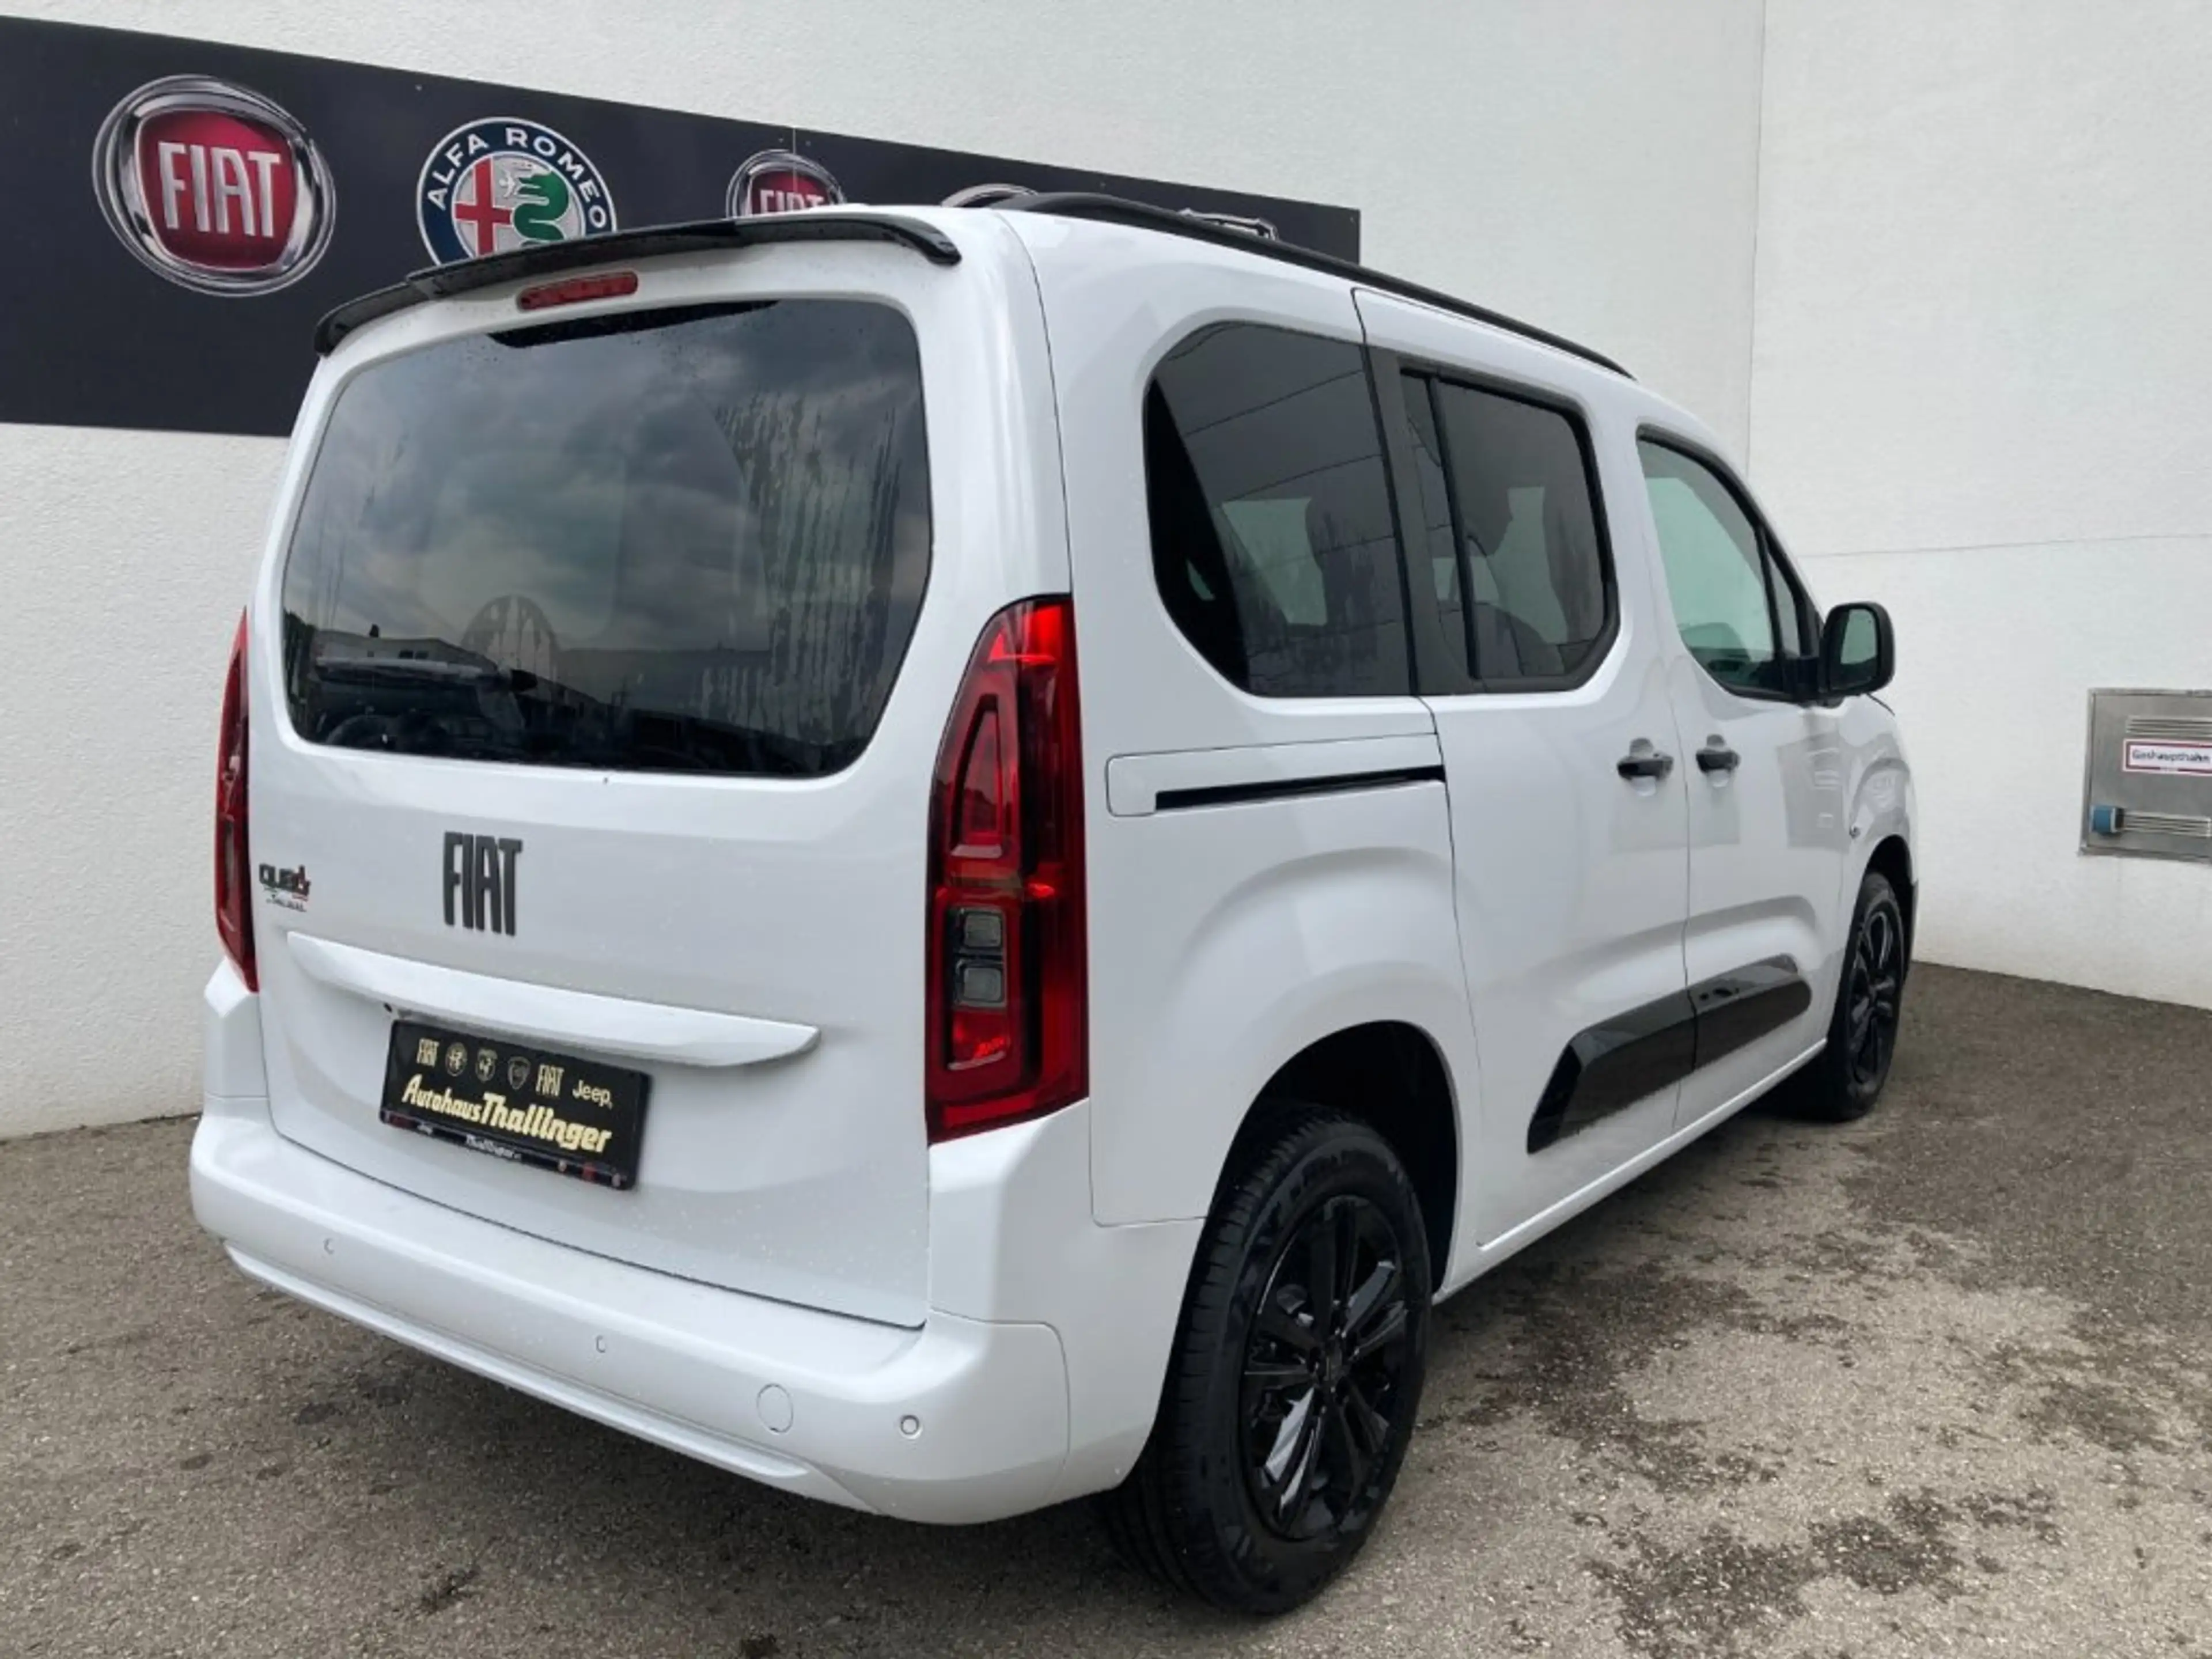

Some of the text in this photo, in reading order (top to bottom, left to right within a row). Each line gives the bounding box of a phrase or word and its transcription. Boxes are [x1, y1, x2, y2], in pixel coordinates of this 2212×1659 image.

[158, 141, 282, 238] FIAT
[427, 127, 607, 229] ALFA ROMEO
[443, 831, 522, 936] FIAT
[416, 1038, 611, 1107] FIAT FIAT Jeep
